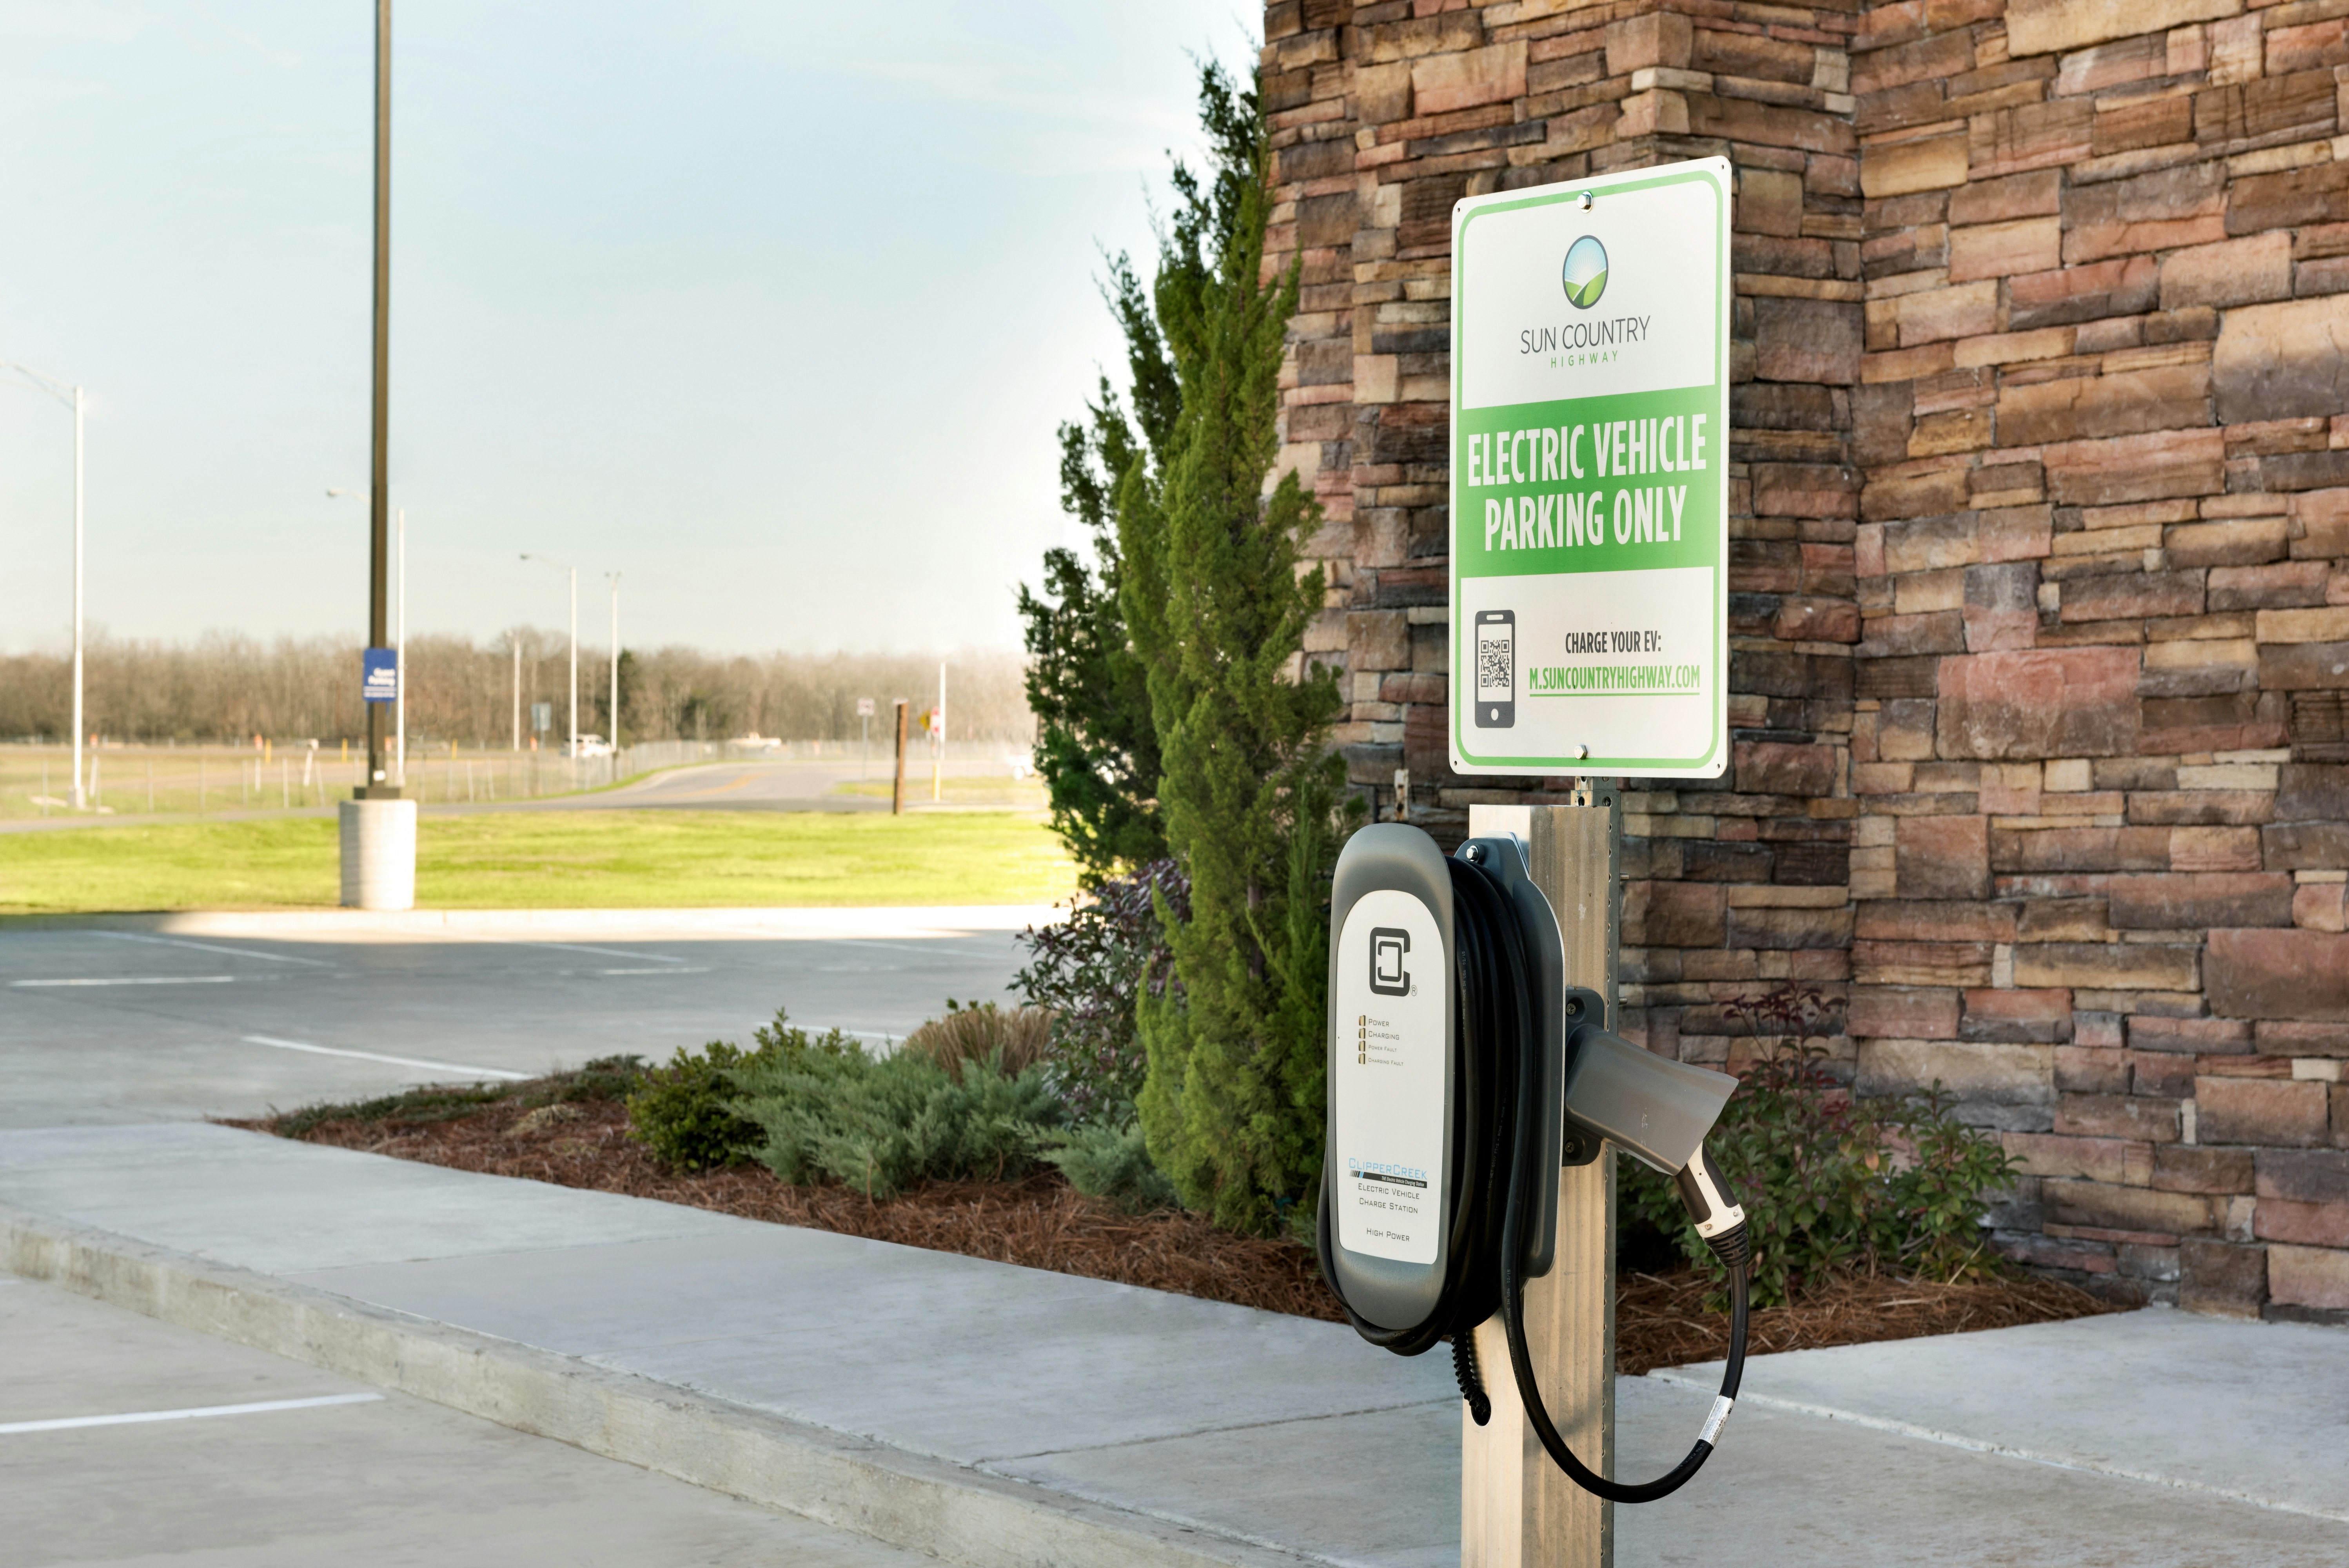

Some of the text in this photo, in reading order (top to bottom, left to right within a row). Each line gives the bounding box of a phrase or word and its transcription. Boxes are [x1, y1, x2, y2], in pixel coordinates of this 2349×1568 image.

[1521, 316, 1650, 354] SUN COUNTRY
[1551, 350, 1618, 368] HIGHWAY
[1468, 414, 1706, 486] ELECTRIC VEHICLE
[1485, 485, 1687, 551] PARKING ONLY
[1566, 630, 1661, 653] CHARGE YOUR EV:
[1530, 665, 1700, 690] M.SUNCOUNTRYHIGHWAY.COM
[1369, 1031, 1400, 1040] CHARGING
